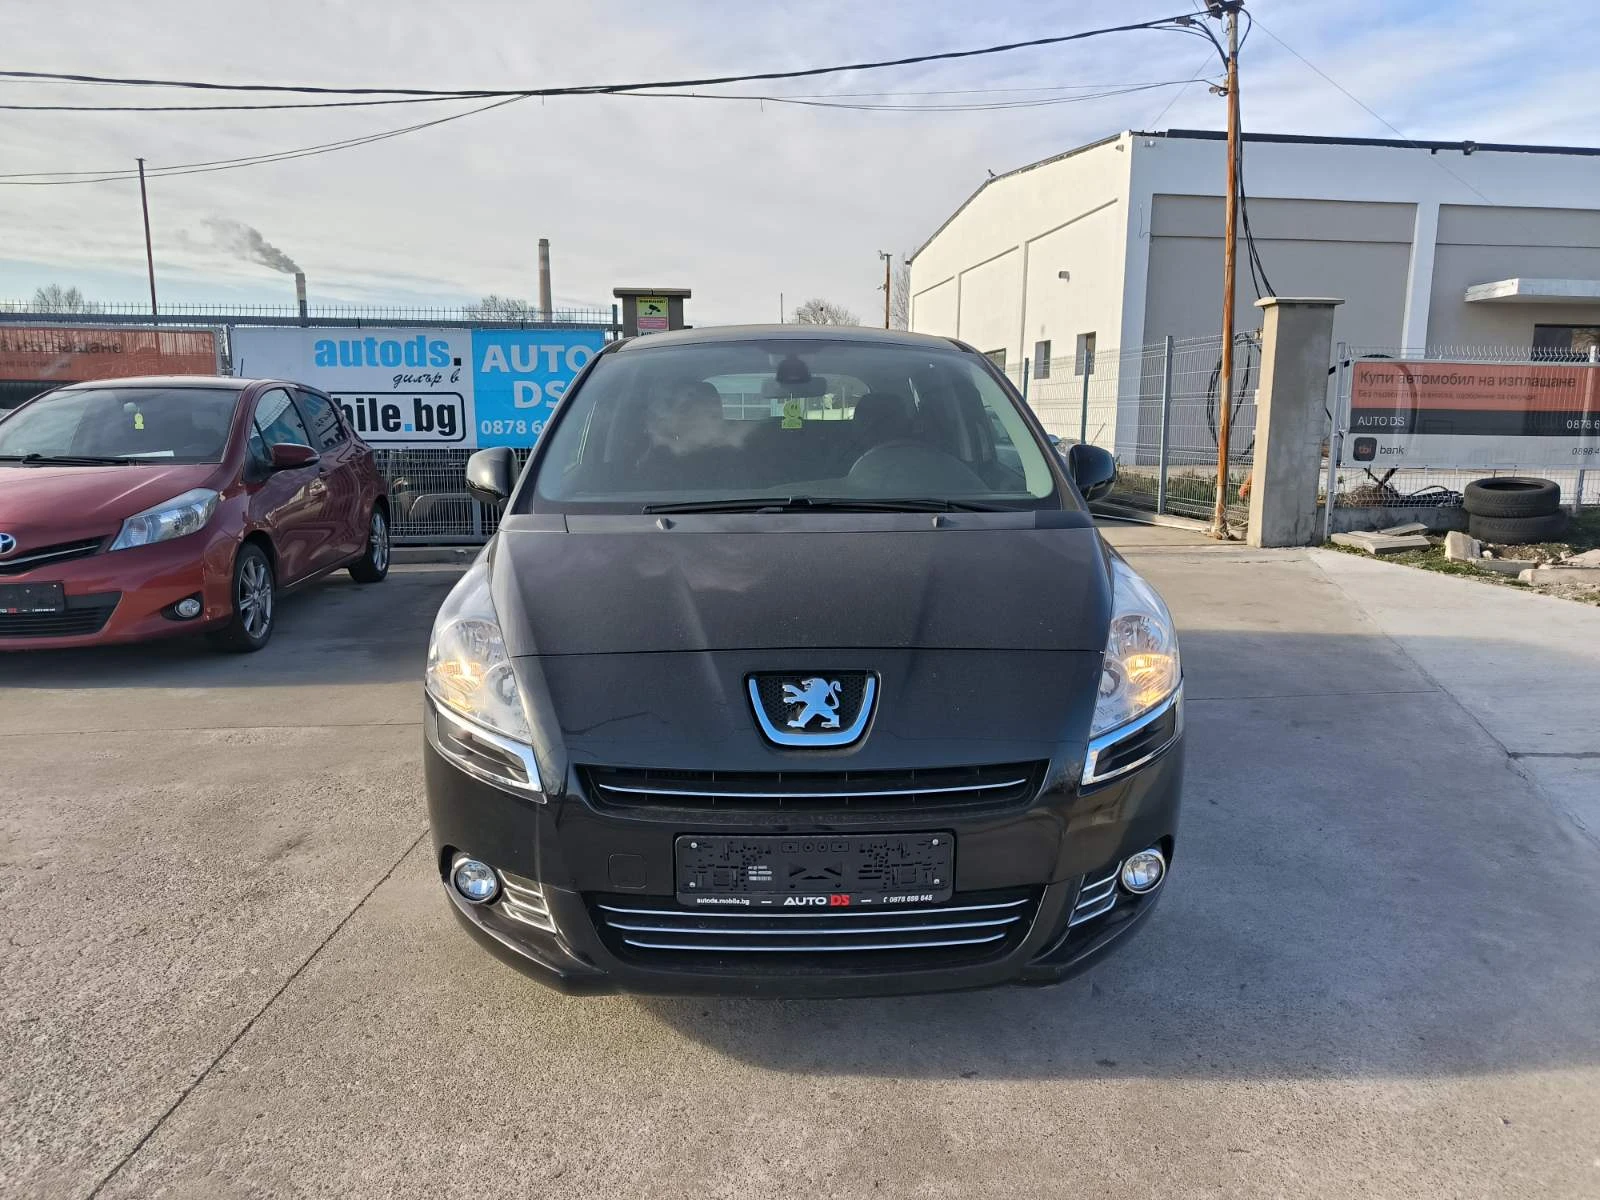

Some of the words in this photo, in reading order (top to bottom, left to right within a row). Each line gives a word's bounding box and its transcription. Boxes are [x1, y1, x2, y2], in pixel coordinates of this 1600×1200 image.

[481, 344, 595, 373] AUTO
[392, 371, 442, 389] дилър
[1360, 371, 1394, 387] Купи
[1399, 373, 1475, 385] автомобил
[1478, 376, 1494, 386] на
[1498, 376, 1576, 388] изплащане
[513, 380, 566, 409] DS
[481, 419, 527, 435] 0878
[531, 419, 546, 435] 6
[1357, 416, 1387, 427] AUTO
[1390, 416, 1405, 426] DS
[1566, 419, 1592, 429] 0878
[1379, 445, 1405, 454] bank
[783, 896, 827, 906] AUTO
[830, 894, 851, 906] DS
